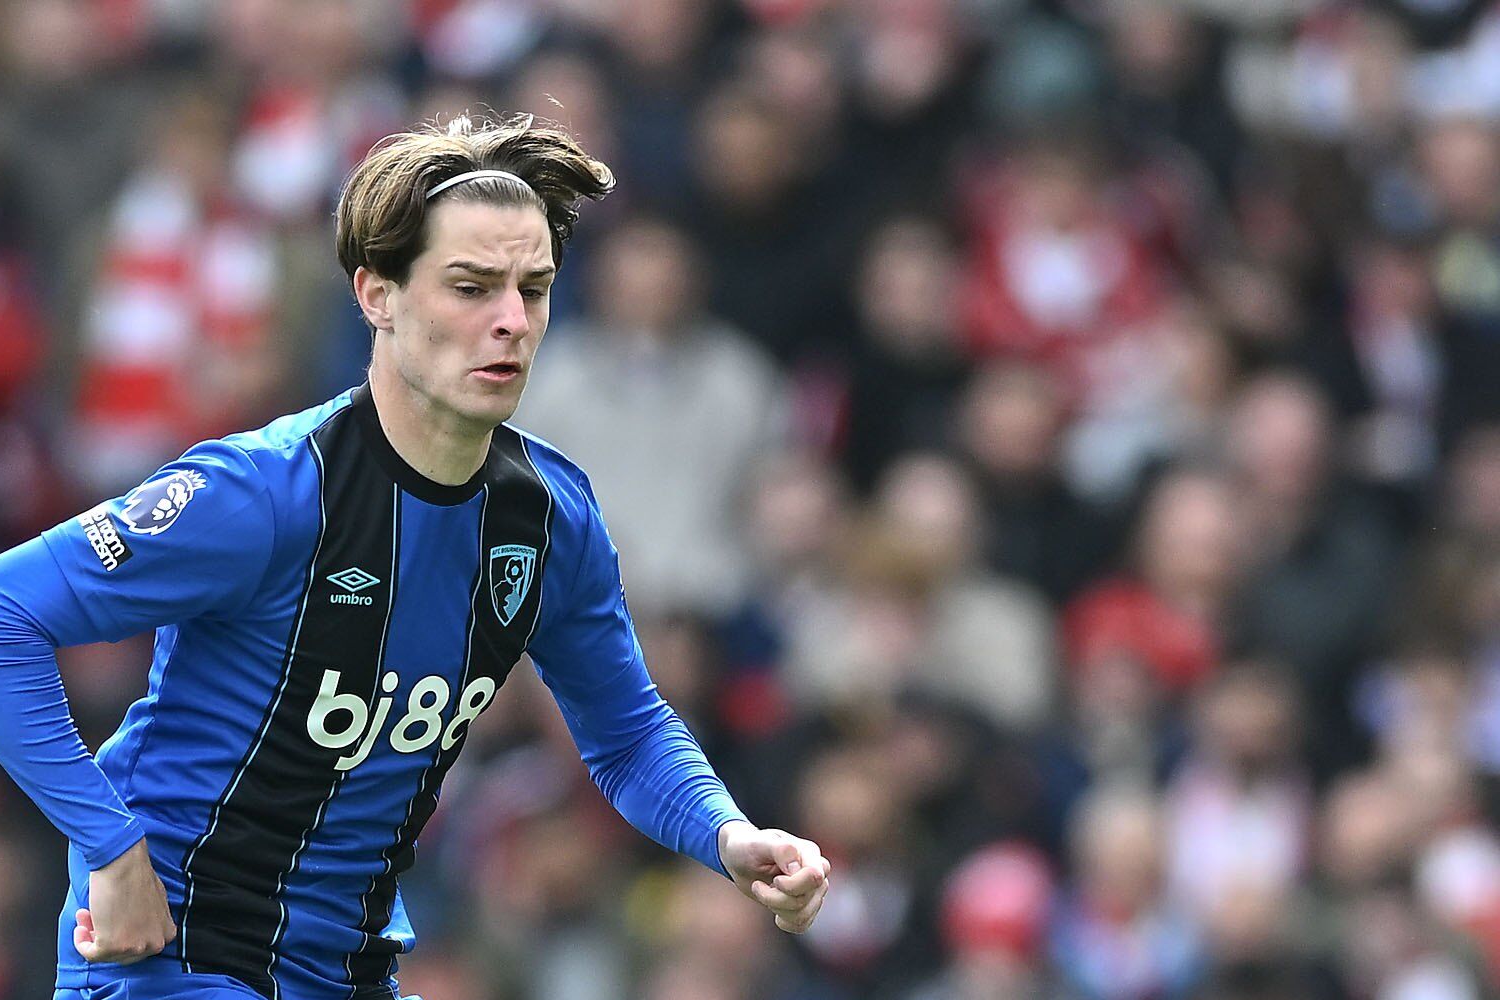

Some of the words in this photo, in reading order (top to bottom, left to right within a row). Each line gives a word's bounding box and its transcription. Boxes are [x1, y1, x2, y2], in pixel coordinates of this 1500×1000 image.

[98, 518, 126, 558] room
[330, 592, 373, 606] umbro
[306, 669, 496, 771] bj88
